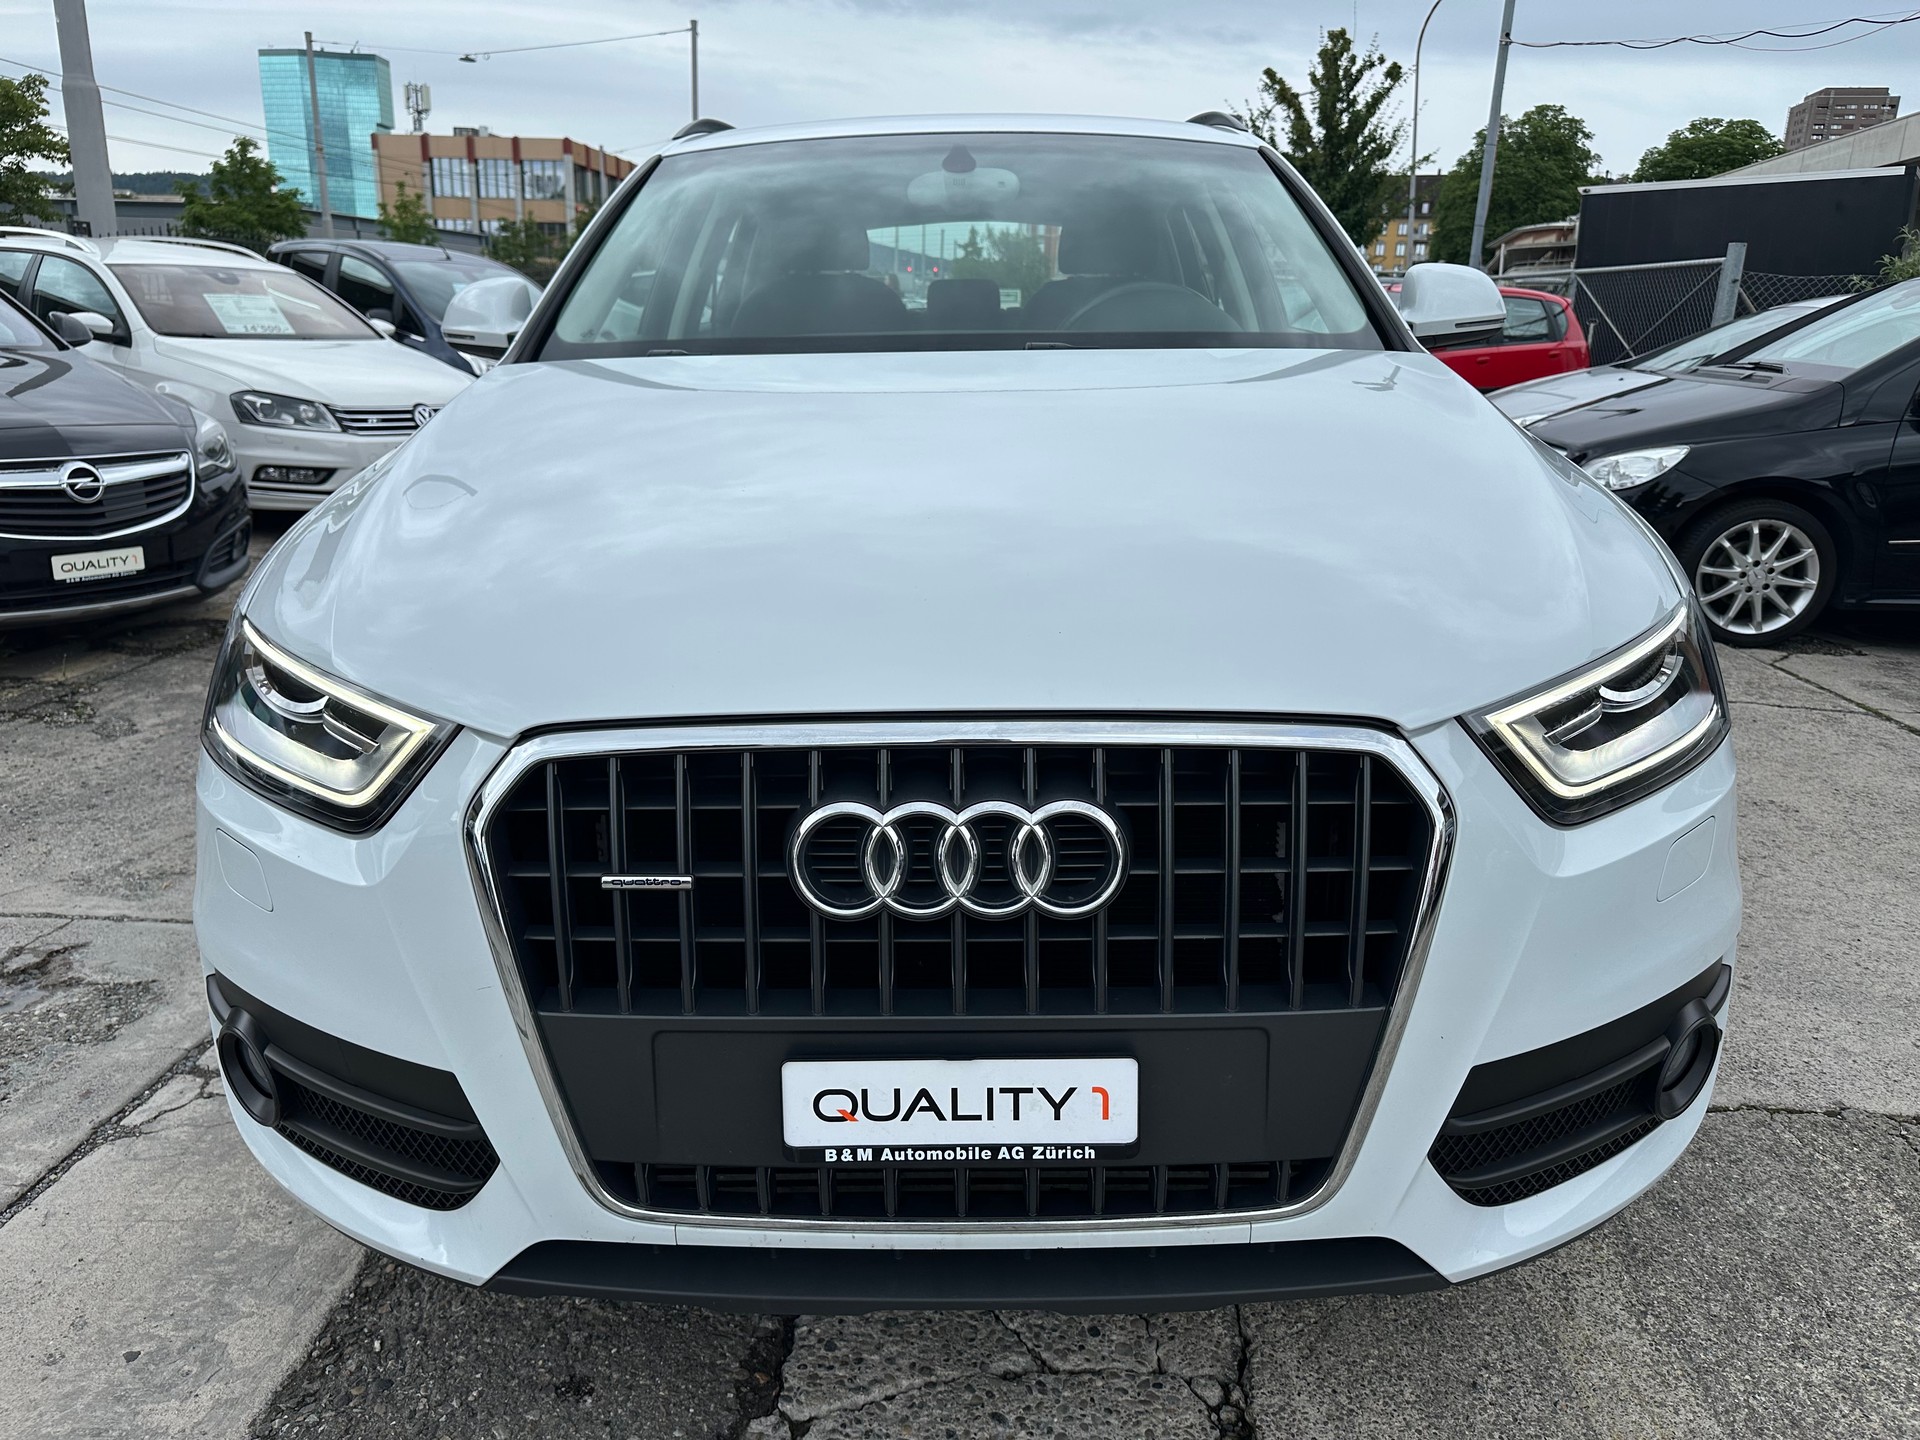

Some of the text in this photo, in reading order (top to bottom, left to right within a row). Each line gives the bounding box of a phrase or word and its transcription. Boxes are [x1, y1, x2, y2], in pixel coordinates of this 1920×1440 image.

[61, 555, 129, 573] QUALITY
[611, 878, 682, 887] quattro
[812, 1086, 1109, 1122] QUALITY 1
[881, 1147, 992, 1161] Automobile
[997, 1146, 1025, 1160] AG
[1032, 1146, 1096, 1160] Zürich
